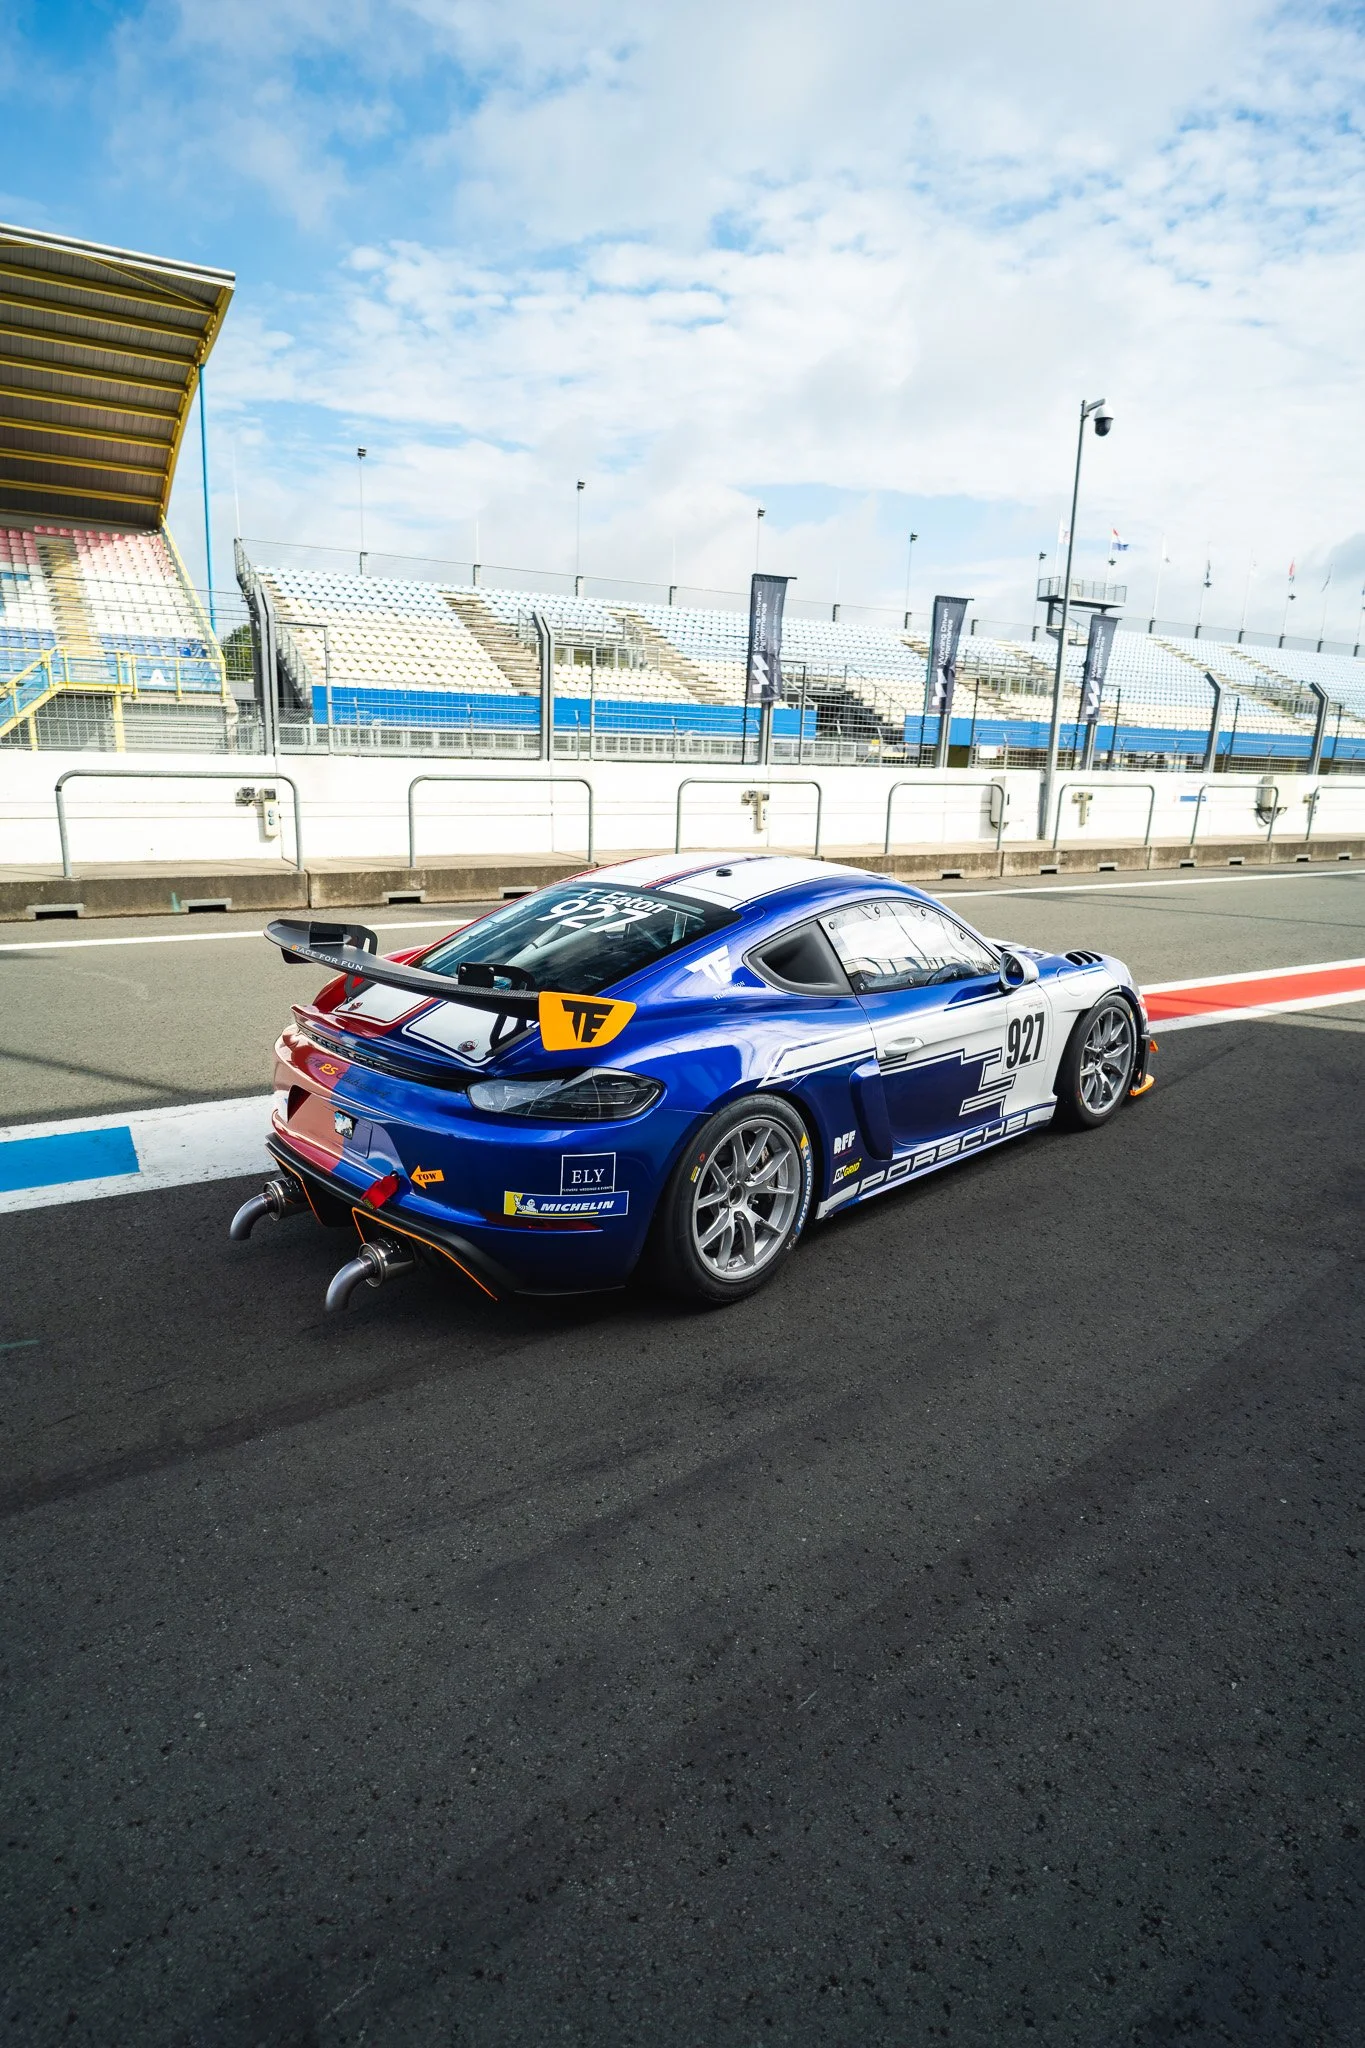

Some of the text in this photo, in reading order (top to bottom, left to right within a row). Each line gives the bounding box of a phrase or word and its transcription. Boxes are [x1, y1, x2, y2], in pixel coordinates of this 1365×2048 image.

[754, 618, 762, 651] Winning
[938, 634, 947, 666] Winning
[535, 899, 653, 933] 927
[577, 888, 669, 914] T. Eaton
[295, 946, 363, 971] RACE FOR FUN
[561, 999, 615, 1043] TE
[1006, 1011, 1045, 1069] 927
[319, 1063, 339, 1075] RS
[859, 1113, 1027, 1193] PORSCHE
[416, 1172, 437, 1181] TOW
[572, 1169, 605, 1184] ELY
[540, 1200, 615, 1212] MICHELIN
[798, 1160, 813, 1229] MICHELIN
